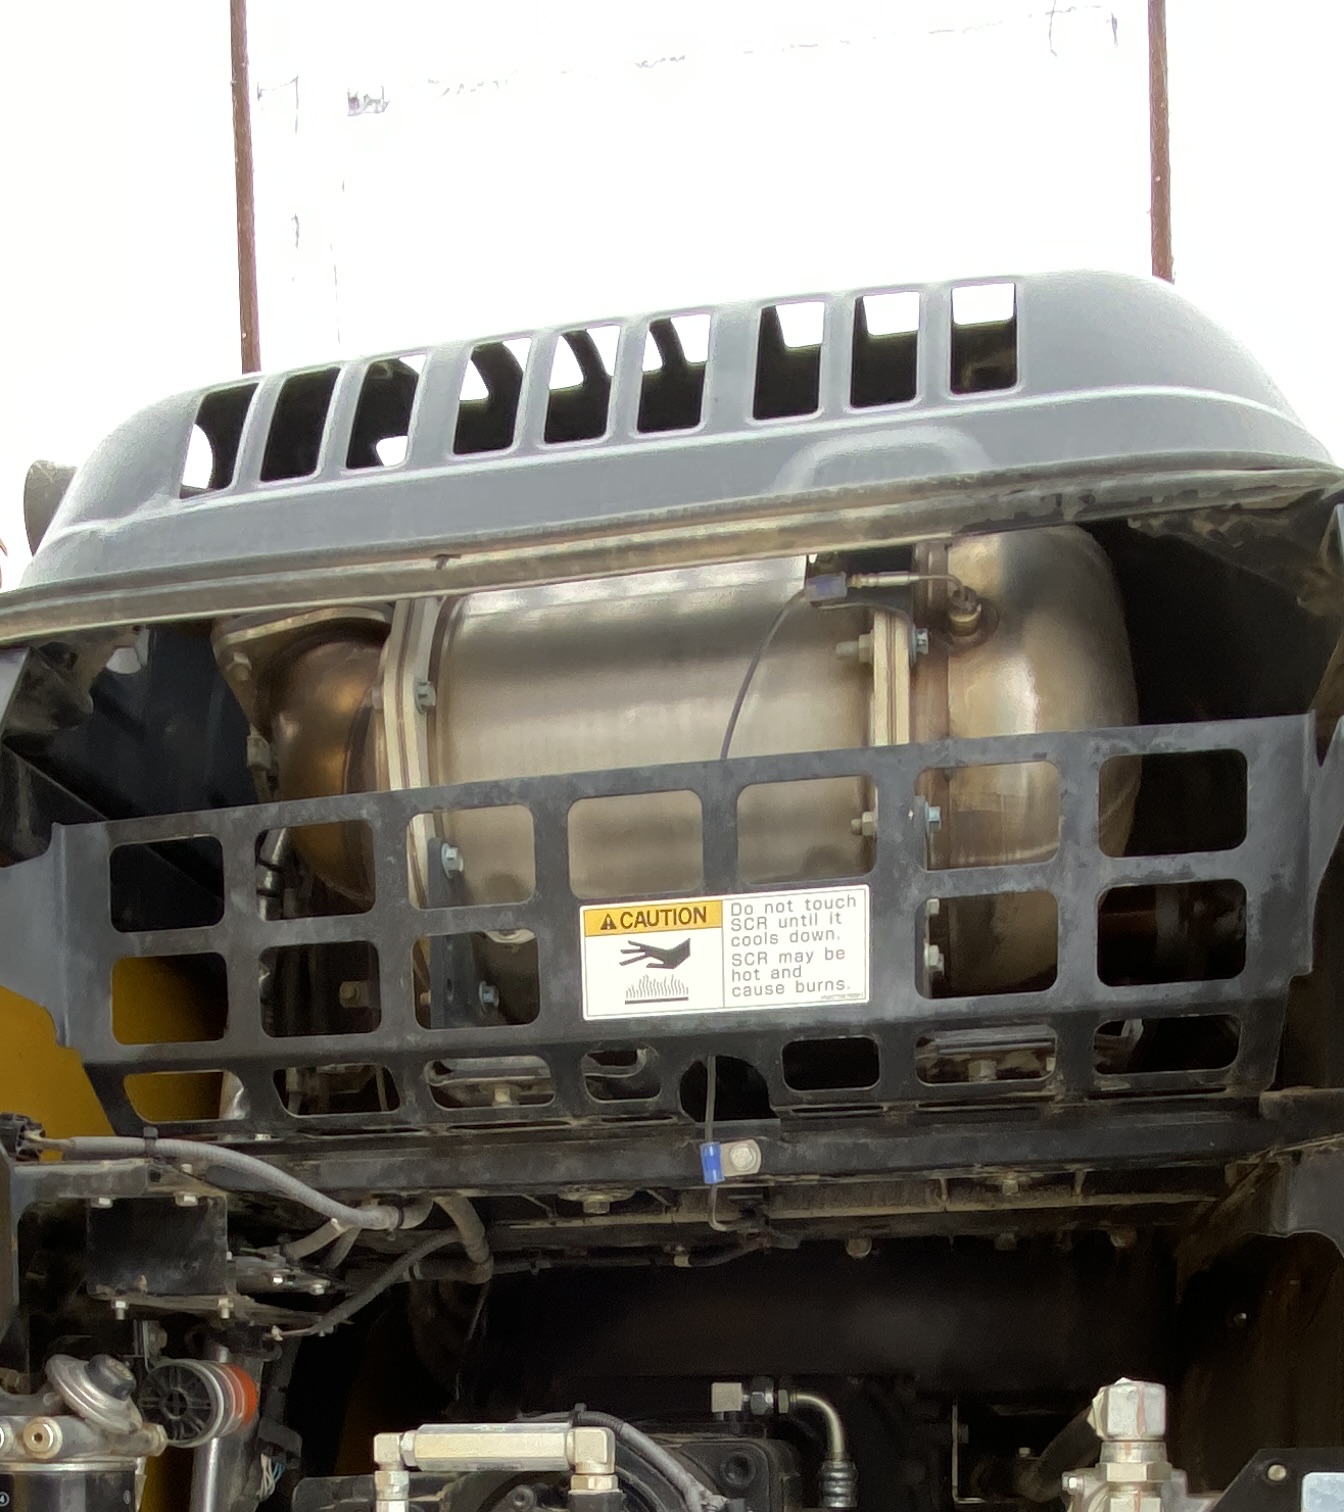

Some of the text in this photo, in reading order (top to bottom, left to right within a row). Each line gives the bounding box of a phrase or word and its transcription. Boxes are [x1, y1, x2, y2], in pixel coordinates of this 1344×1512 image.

[730, 894, 857, 917] Do not touch
[620, 906, 707, 929] CAUTION
[730, 911, 842, 932] SCR until it
[730, 929, 841, 947] cools down.
[731, 946, 846, 967] SCR may be
[731, 964, 803, 982] hot and
[731, 979, 851, 998] cause burns.
